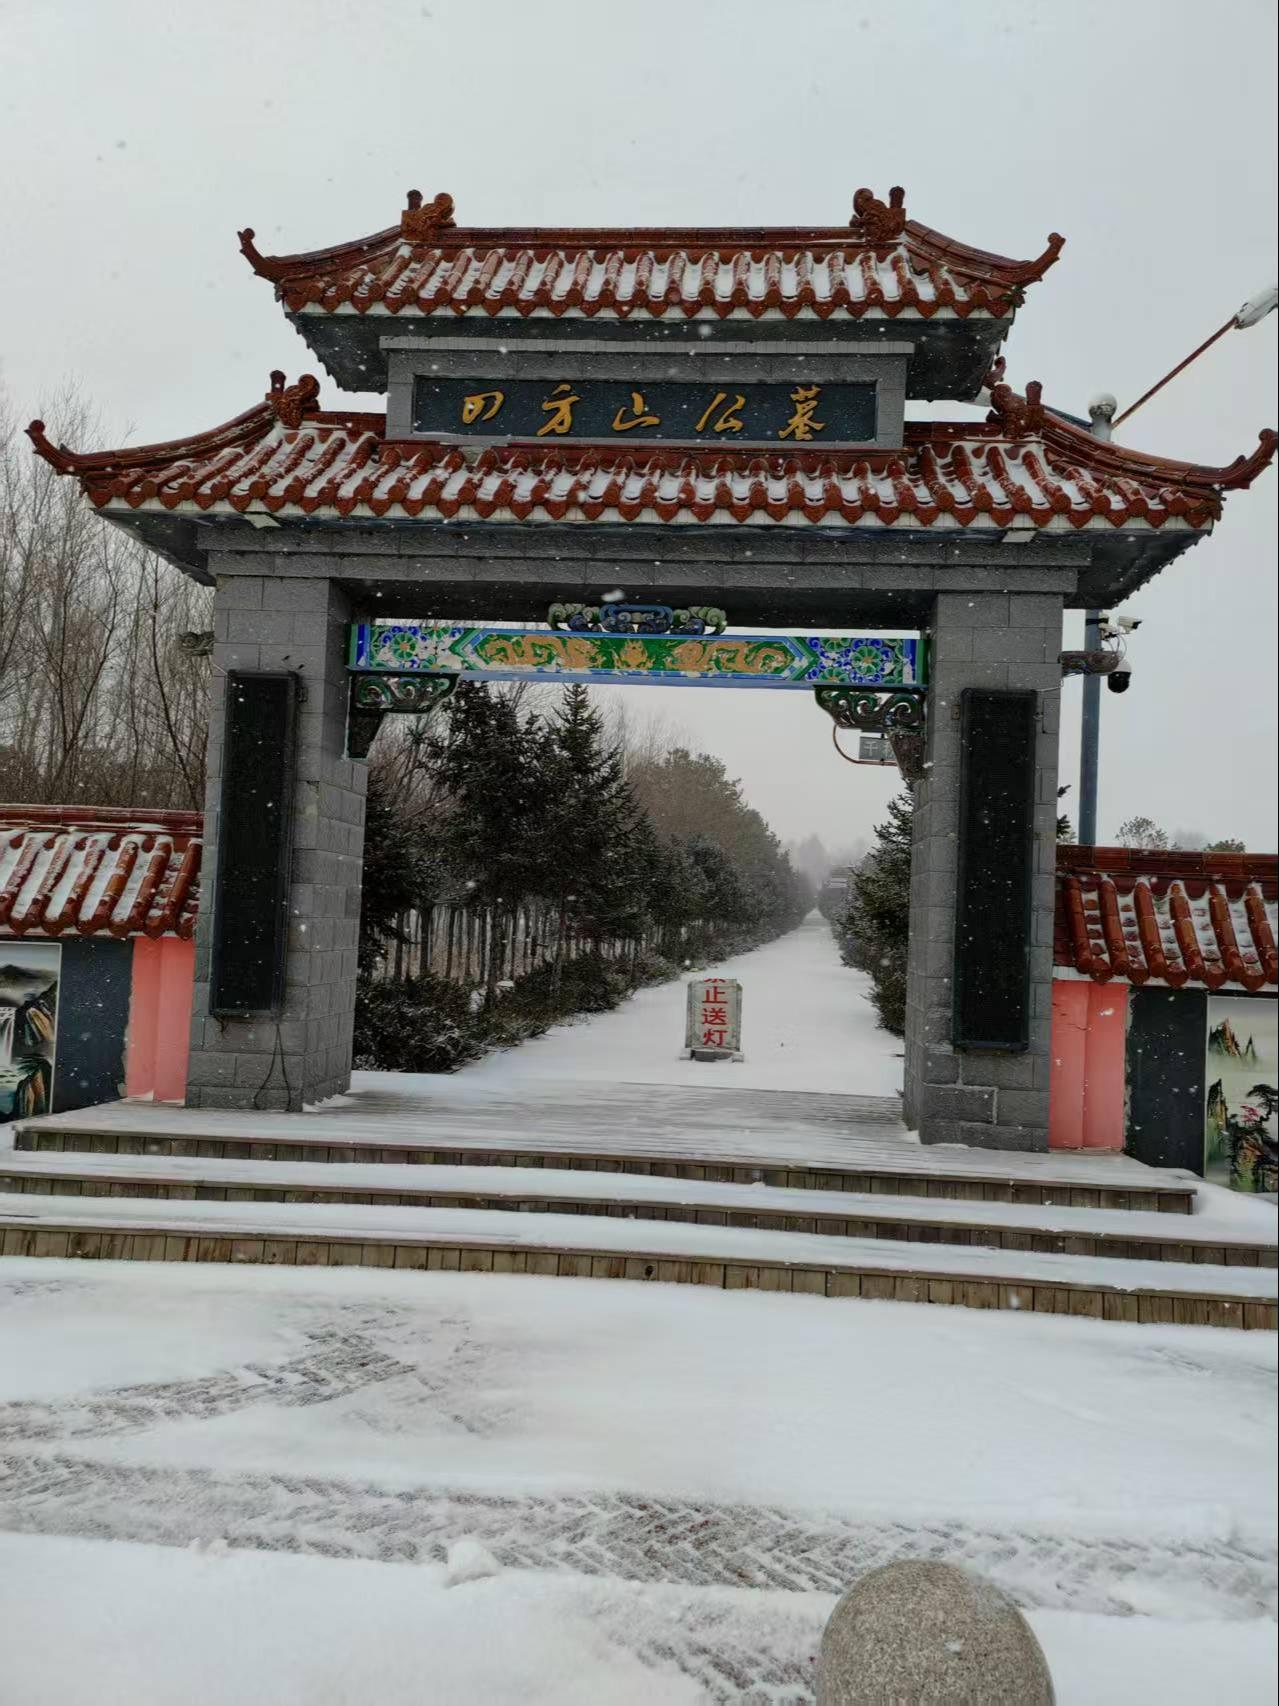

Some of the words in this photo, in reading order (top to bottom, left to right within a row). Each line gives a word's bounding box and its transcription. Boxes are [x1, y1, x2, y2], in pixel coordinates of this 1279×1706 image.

[462, 384, 825, 440] 四方山公墓
[701, 978, 728, 1046] 止送灯
